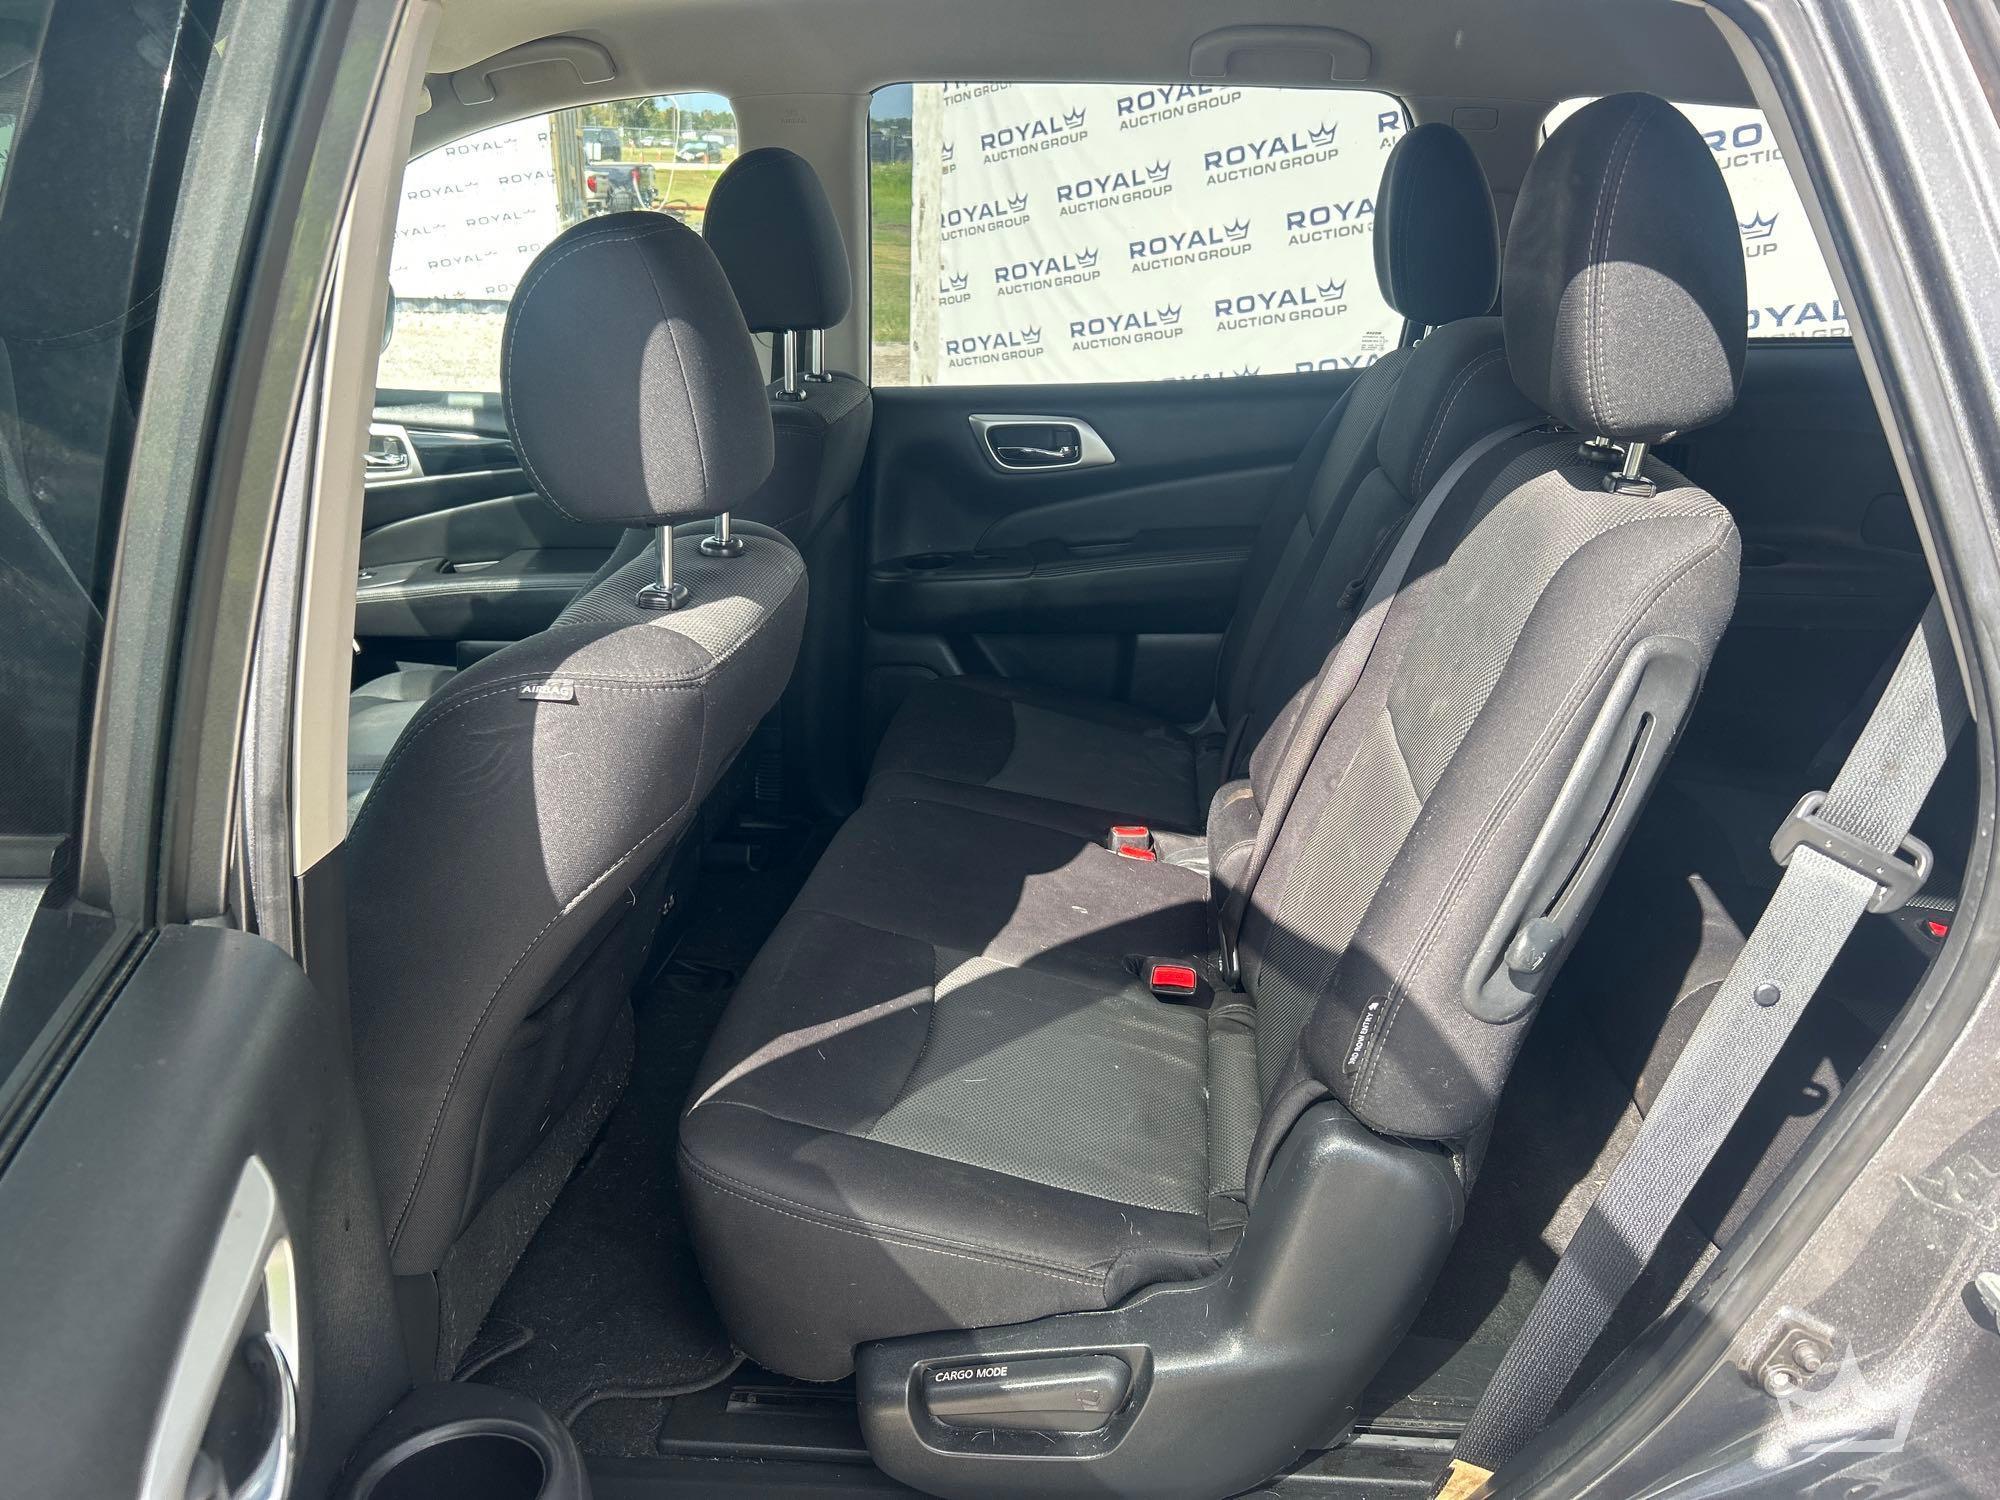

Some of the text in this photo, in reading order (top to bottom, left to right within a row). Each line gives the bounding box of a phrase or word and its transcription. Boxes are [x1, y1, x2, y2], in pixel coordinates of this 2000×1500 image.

[944, 91, 971, 106] TION
[1117, 84, 1213, 116] ROYAL
[1120, 91, 1241, 131] AUCTION GROUP
[980, 117, 1062, 151] ROYAL
[445, 140, 503, 156] ROYAL
[983, 131, 1088, 165] AUCTION GROUP
[1204, 133, 1308, 171] ROYAL
[1718, 149, 1784, 170] UCTIO
[1206, 149, 1339, 186] AUCTION GROUP
[407, 185, 464, 200] ROYAL
[1057, 169, 1146, 203] ROYAL
[1059, 184, 1172, 217] AUCTION GROUP
[466, 211, 522, 226] ROYAL
[1286, 198, 1375, 231] ROYA
[396, 226, 431, 238] YAL
[941, 215, 1030, 241] UCTION GROUP
[1288, 223, 1364, 246] AUCTION
[1129, 227, 1224, 259] ROYAL
[428, 254, 482, 269] ROYAL
[995, 255, 1076, 284] ROYAL
[1131, 243, 1251, 273] AUCTION GROUP
[997, 270, 1101, 296] AUCTION GROUP
[939, 293, 971, 306] ROUP
[1215, 286, 1317, 317] ROYAL
[1070, 311, 1157, 338] ROYAL
[1216, 304, 1348, 332] AUCTION GROUP
[946, 331, 1021, 356] ROYAL
[1072, 327, 1183, 352] AUCTION GROUP
[949, 347, 1044, 368] AUCTION GROUP
[521, 685, 569, 696] AIRBAG
[1354, 1034, 1365, 1052] ROW
[1360, 1012, 1374, 1035] ENTRY
[935, 1366, 1008, 1382] CARGO MODE
